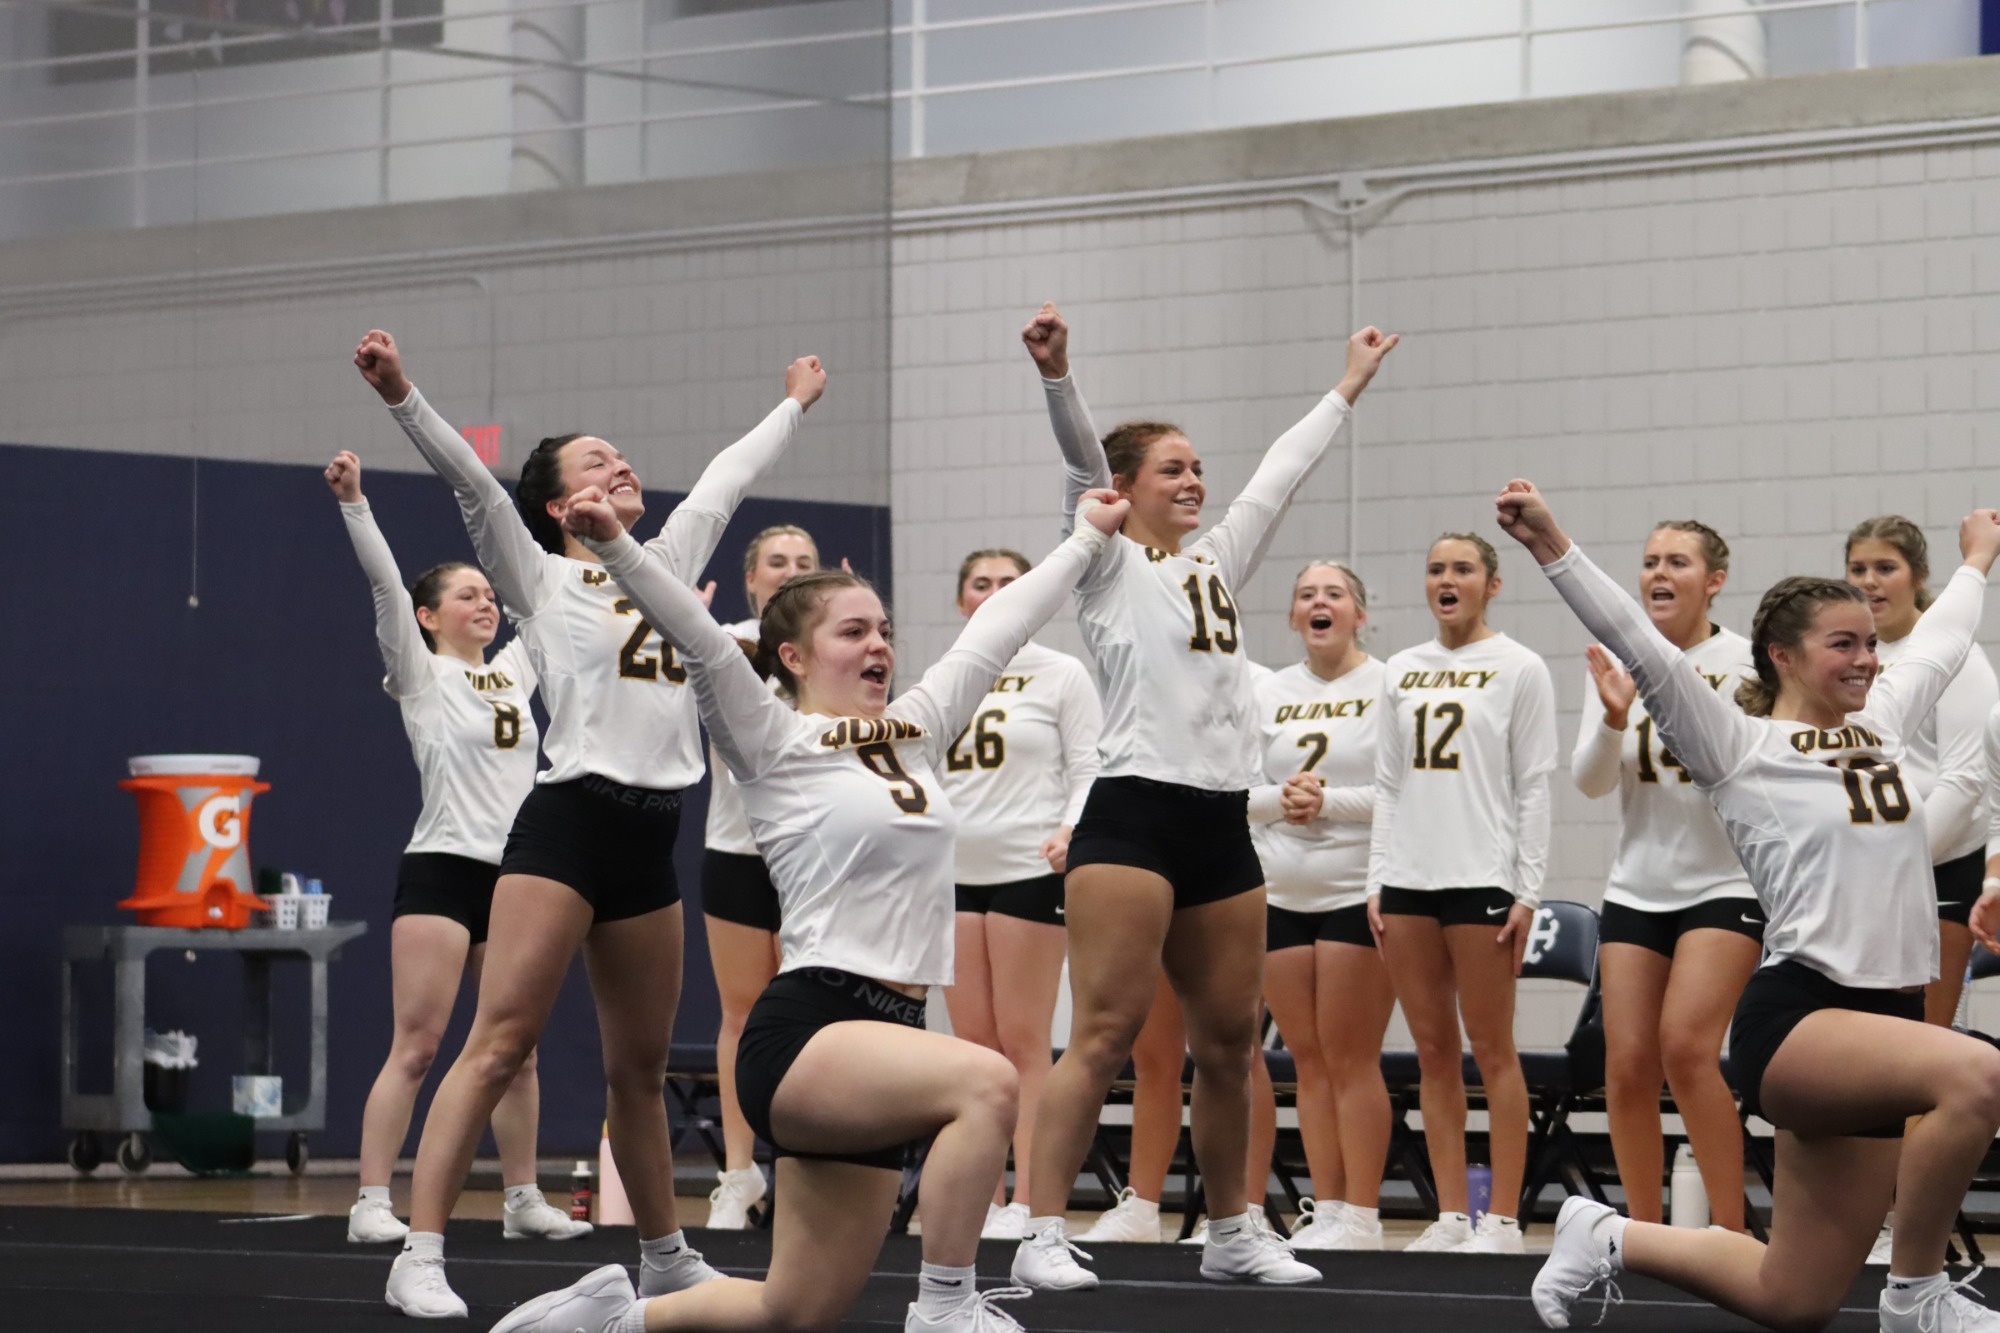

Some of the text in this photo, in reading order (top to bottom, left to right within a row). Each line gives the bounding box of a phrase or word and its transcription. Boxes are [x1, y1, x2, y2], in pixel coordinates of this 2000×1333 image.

[1182, 573, 1238, 655] 19
[1399, 670, 1499, 691] QUINCY
[1274, 698, 1375, 724] QUINCY
[1412, 701, 1465, 771] 12
[857, 741, 928, 815] 9
[199, 795, 241, 849] G
[853, 982, 919, 1024] NIKE
